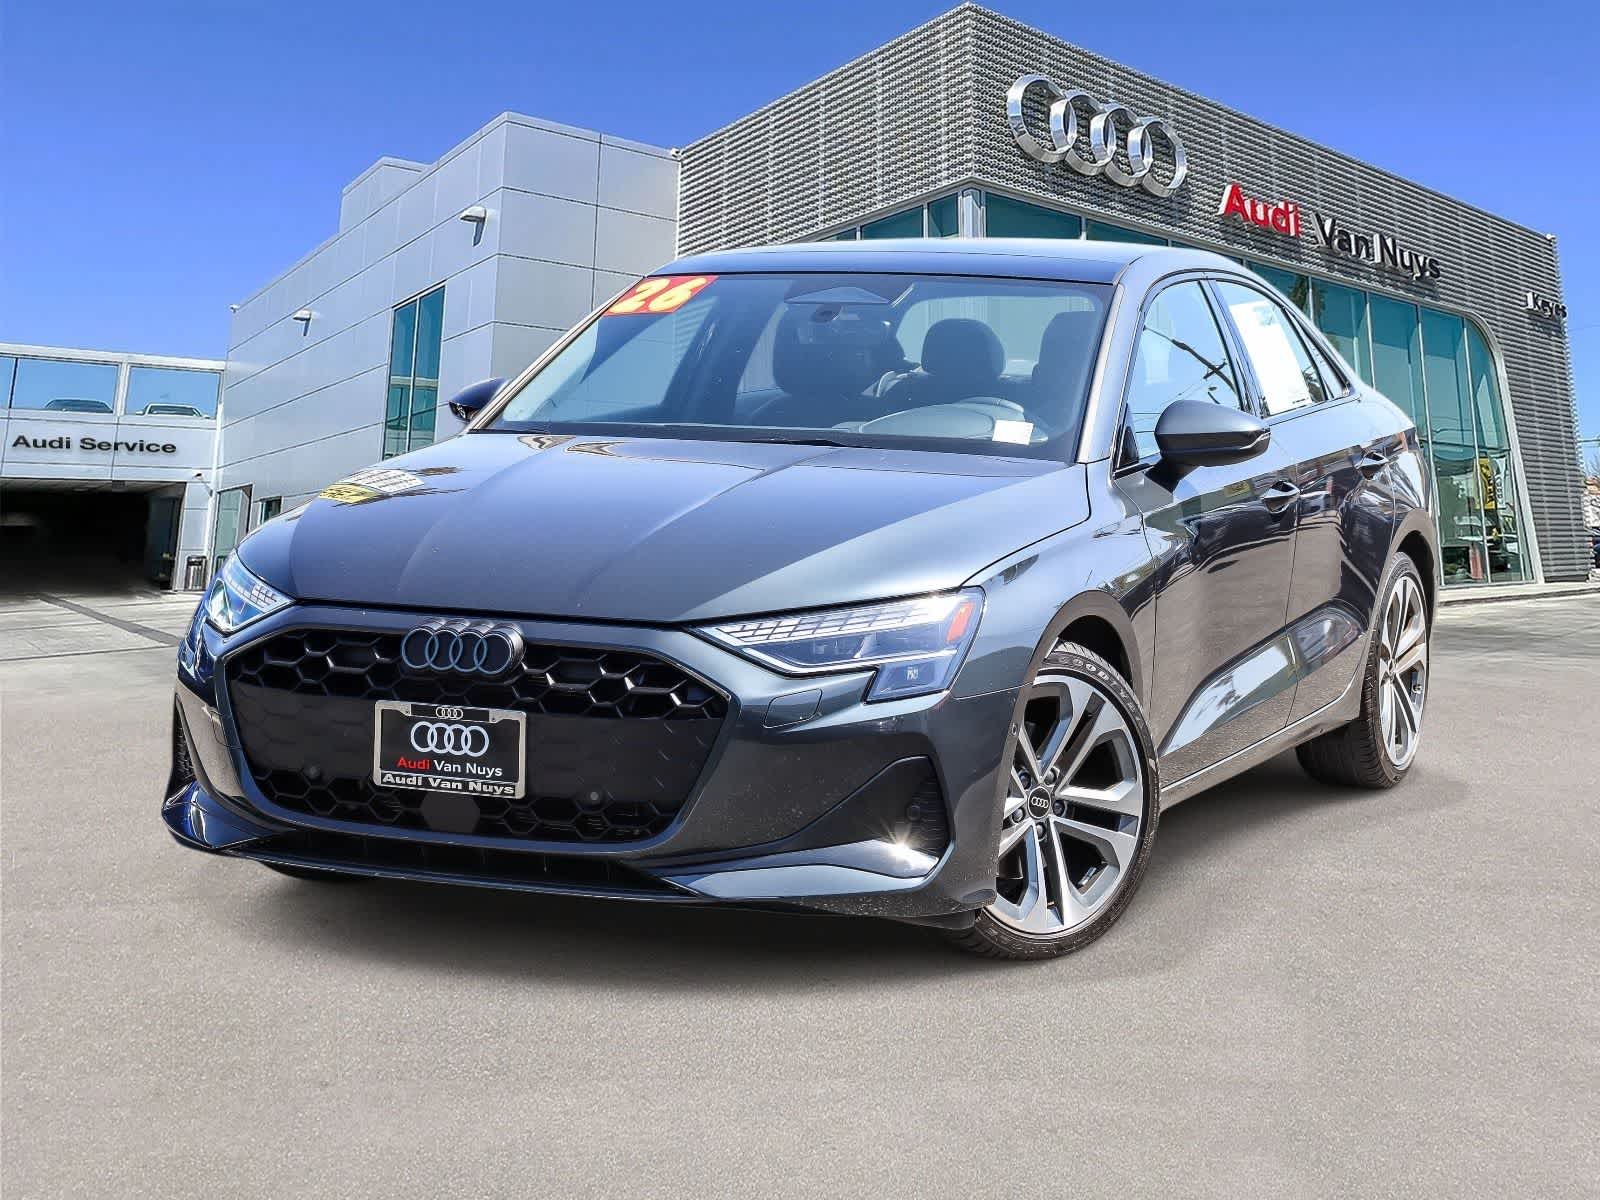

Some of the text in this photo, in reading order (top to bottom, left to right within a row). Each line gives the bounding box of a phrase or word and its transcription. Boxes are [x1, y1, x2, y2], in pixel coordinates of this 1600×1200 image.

[1218, 182, 1441, 281] Audi Van Nuys
[608, 277, 707, 314] 26
[12, 434, 177, 454] Audi Service
[396, 756, 503, 778] Audi Van Nuys
[383, 773, 515, 795] Audi Van Nuys
